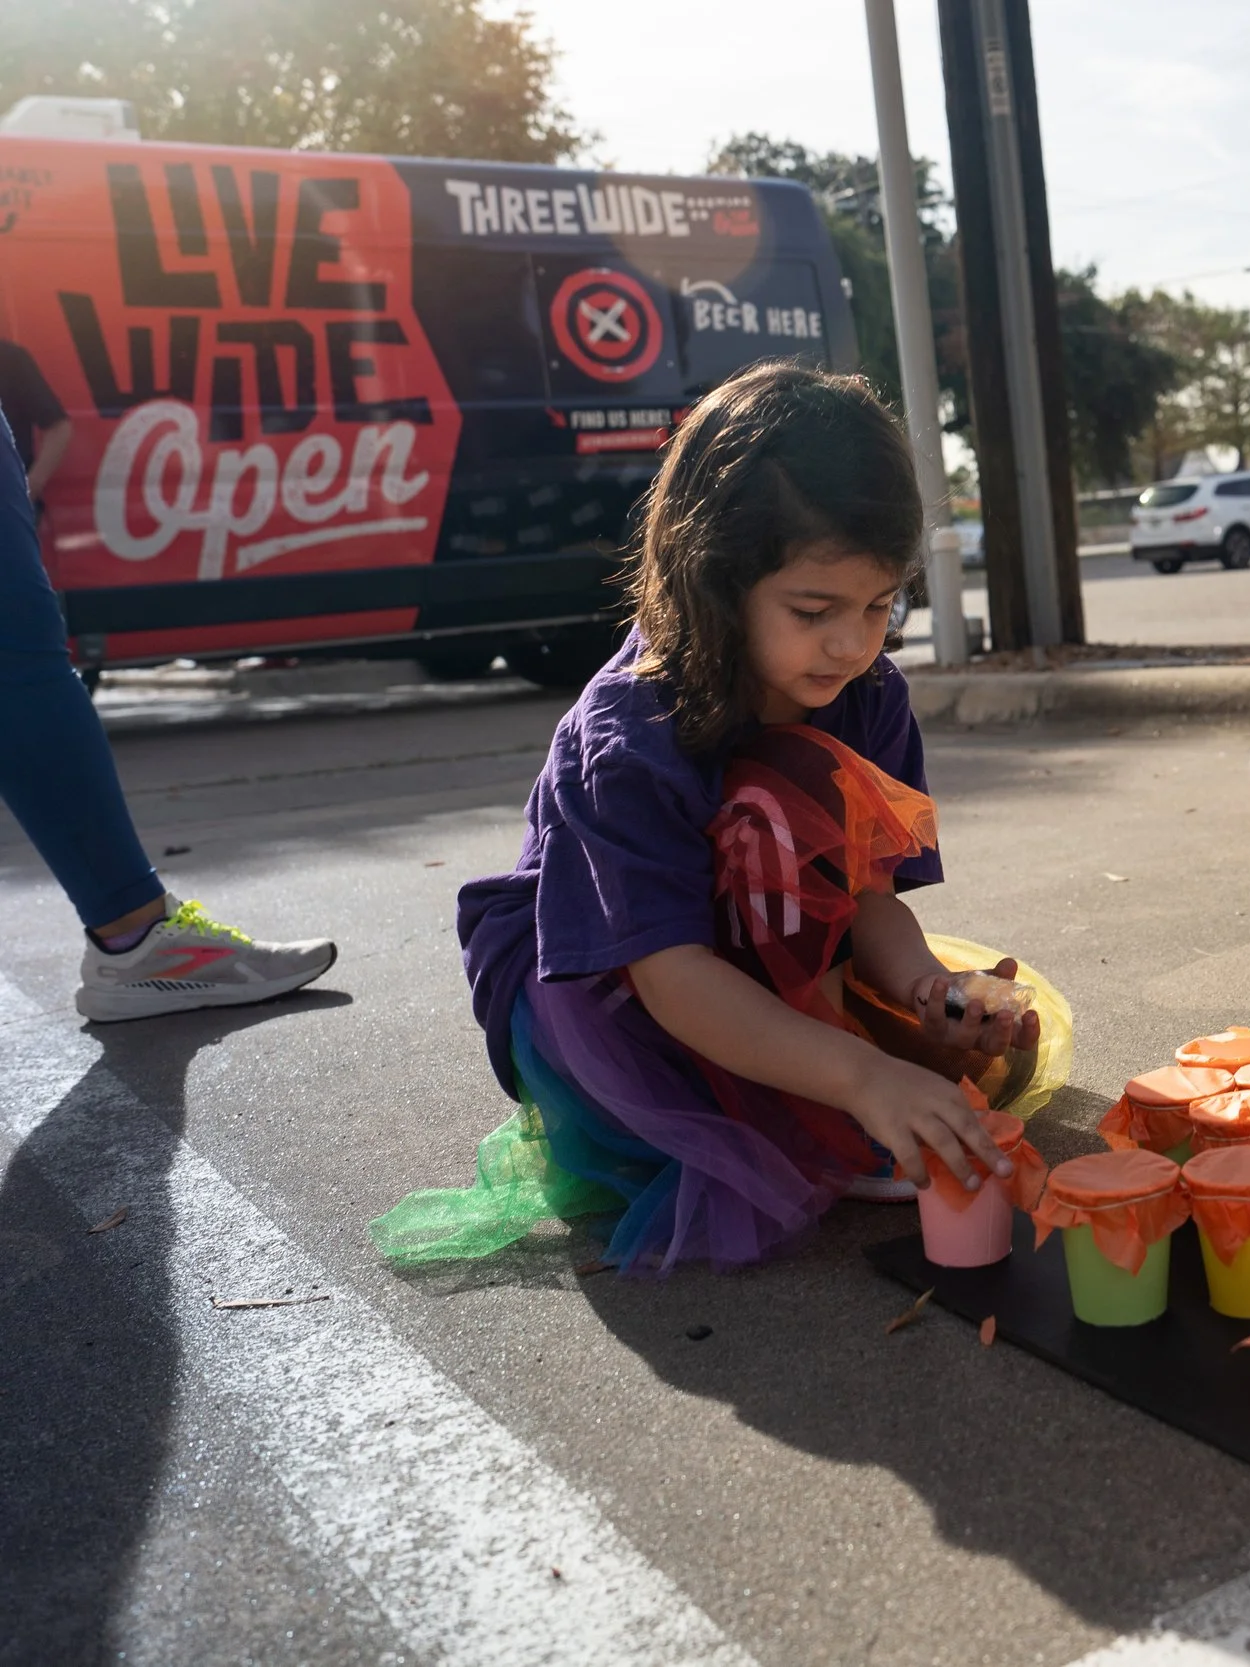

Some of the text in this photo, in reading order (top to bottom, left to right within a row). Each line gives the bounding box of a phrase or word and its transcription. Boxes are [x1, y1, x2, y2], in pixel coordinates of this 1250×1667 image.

[105, 162, 388, 311] LIVE
[765, 306, 823, 340] HERE
[570, 409, 605, 429] FIND
[606, 409, 628, 428] US
[93, 398, 430, 582] Open
